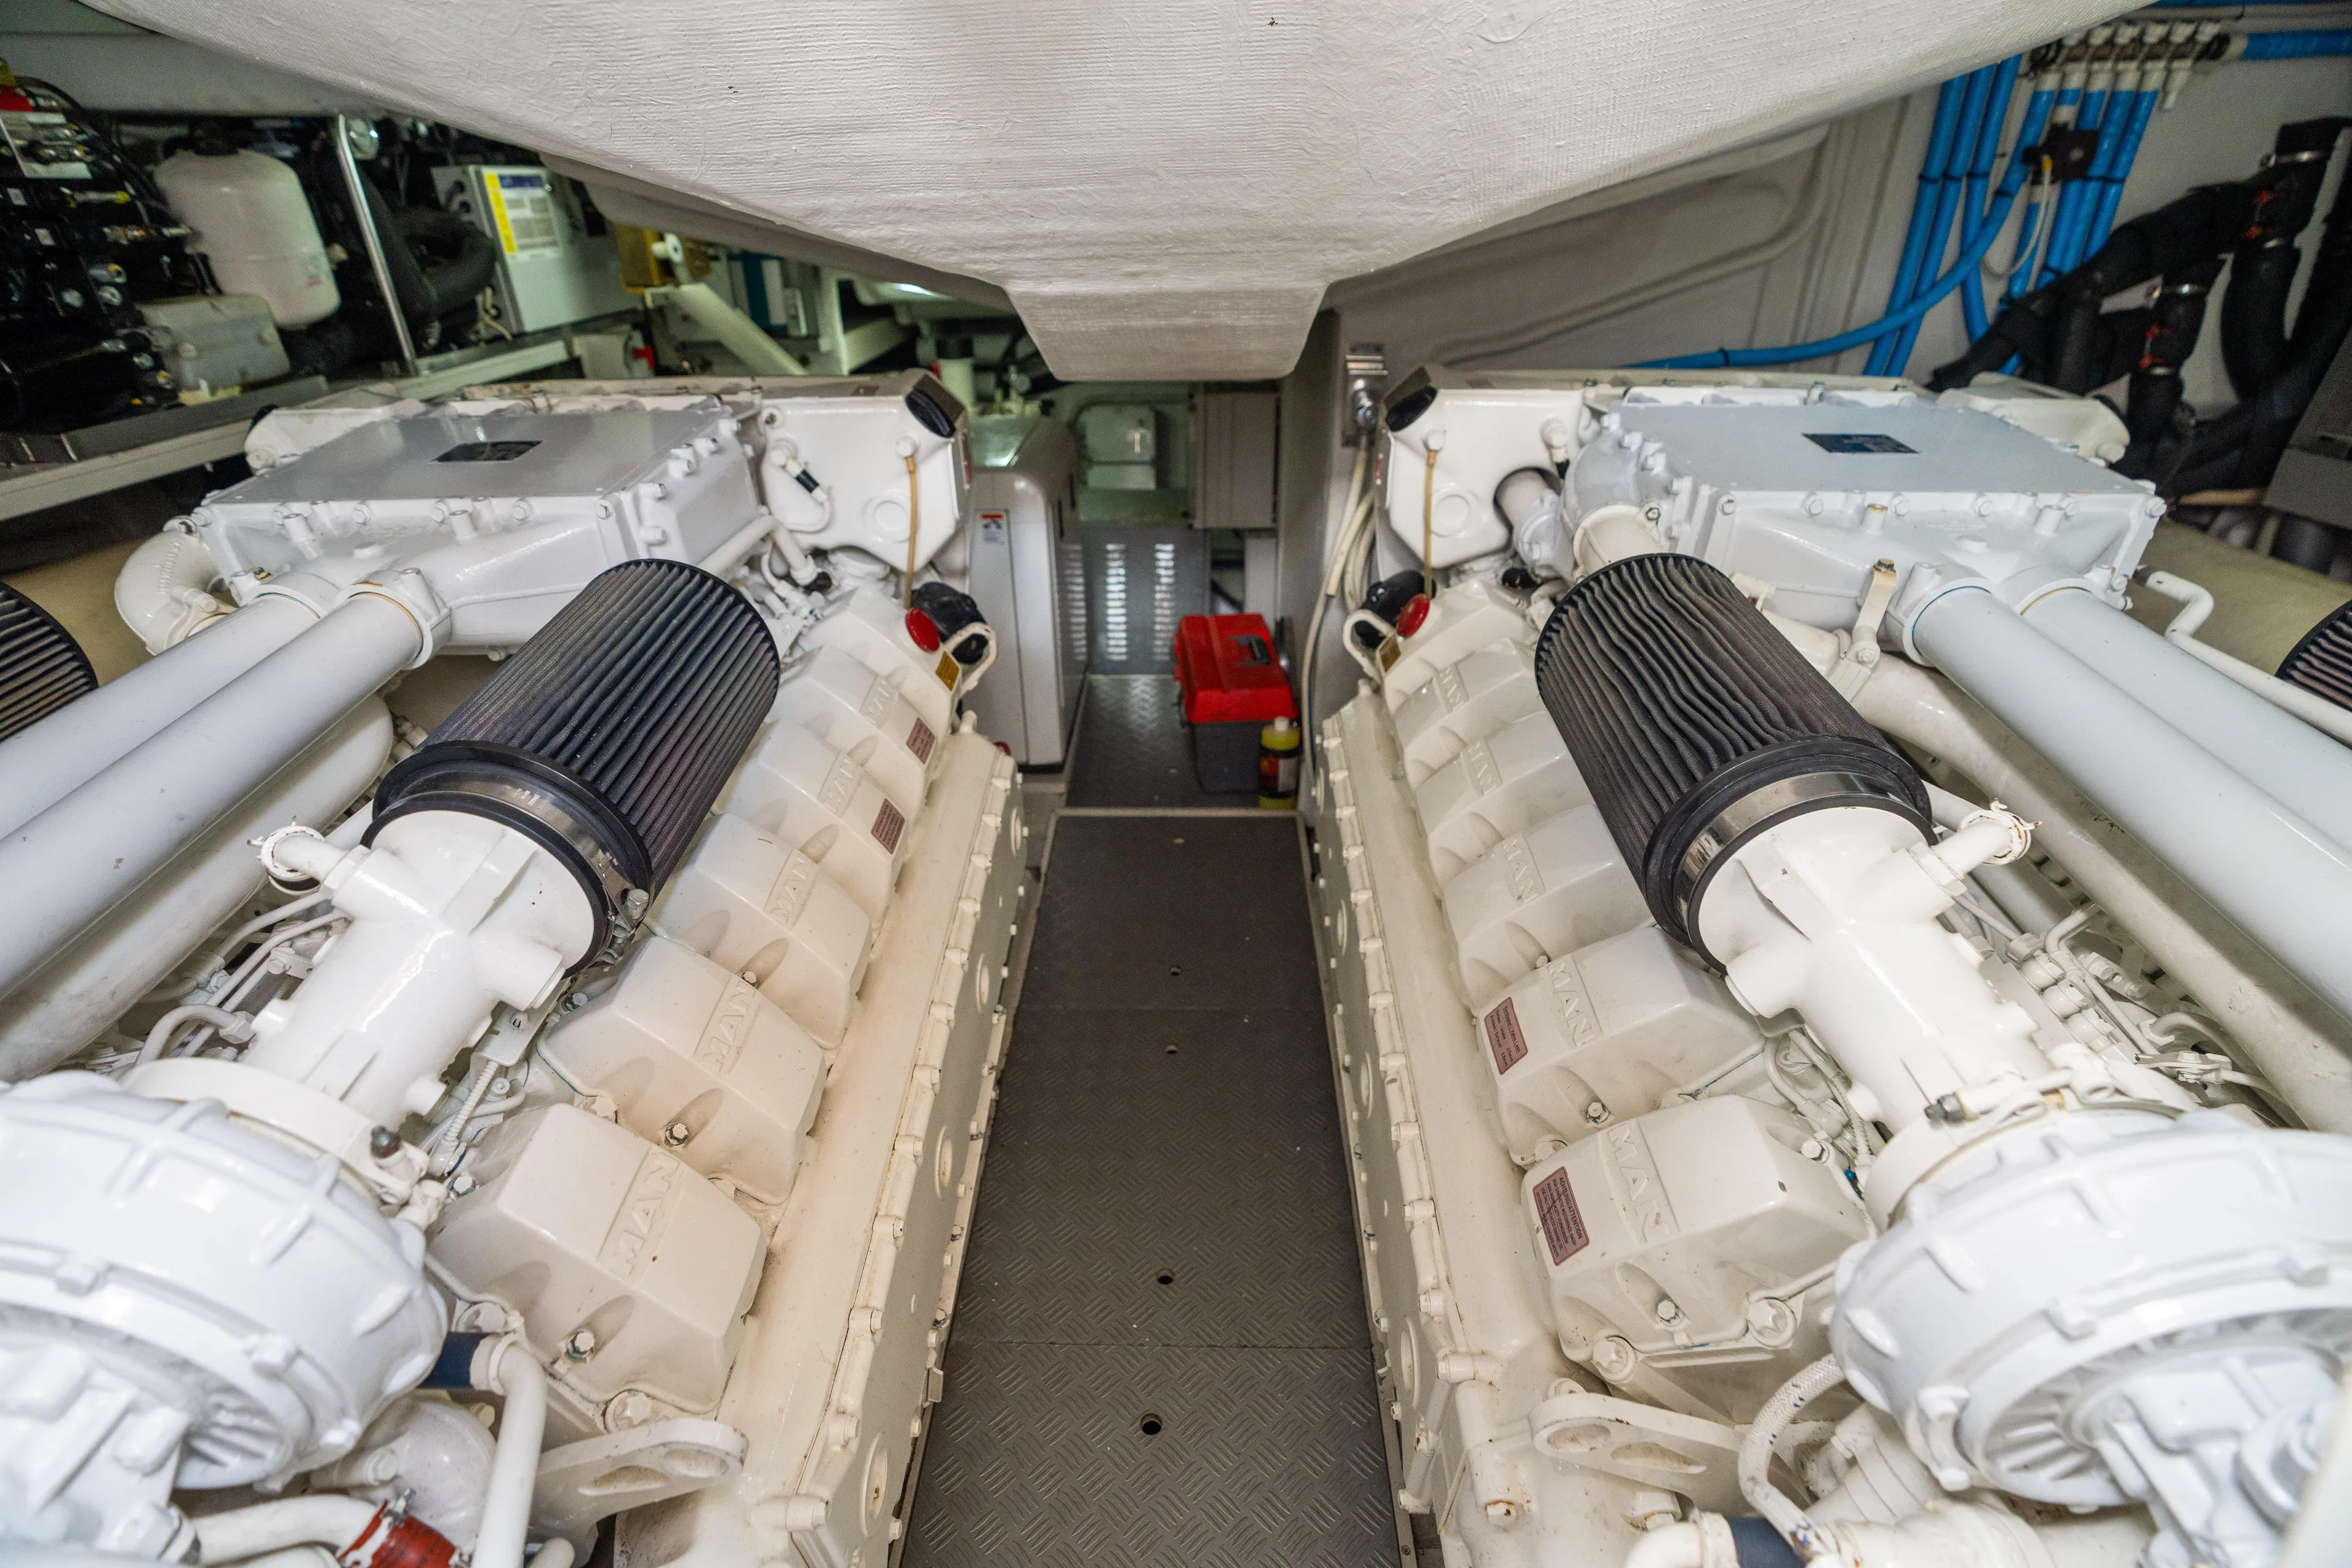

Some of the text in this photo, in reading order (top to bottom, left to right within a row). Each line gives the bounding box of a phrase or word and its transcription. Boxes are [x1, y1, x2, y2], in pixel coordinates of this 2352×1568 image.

[822, 756, 857, 813] MAN
[1467, 741, 1496, 795] MAN
[770, 854, 813, 924] MAN
[1502, 839, 1539, 903] MAN
[700, 980, 756, 1072] MAN
[1547, 962, 1595, 1047] MAN
[609, 1152, 680, 1276] MAN
[1559, 1177, 1583, 1240] ACHTUNG/ATTENTION
[1607, 1123, 1670, 1242] MAN
